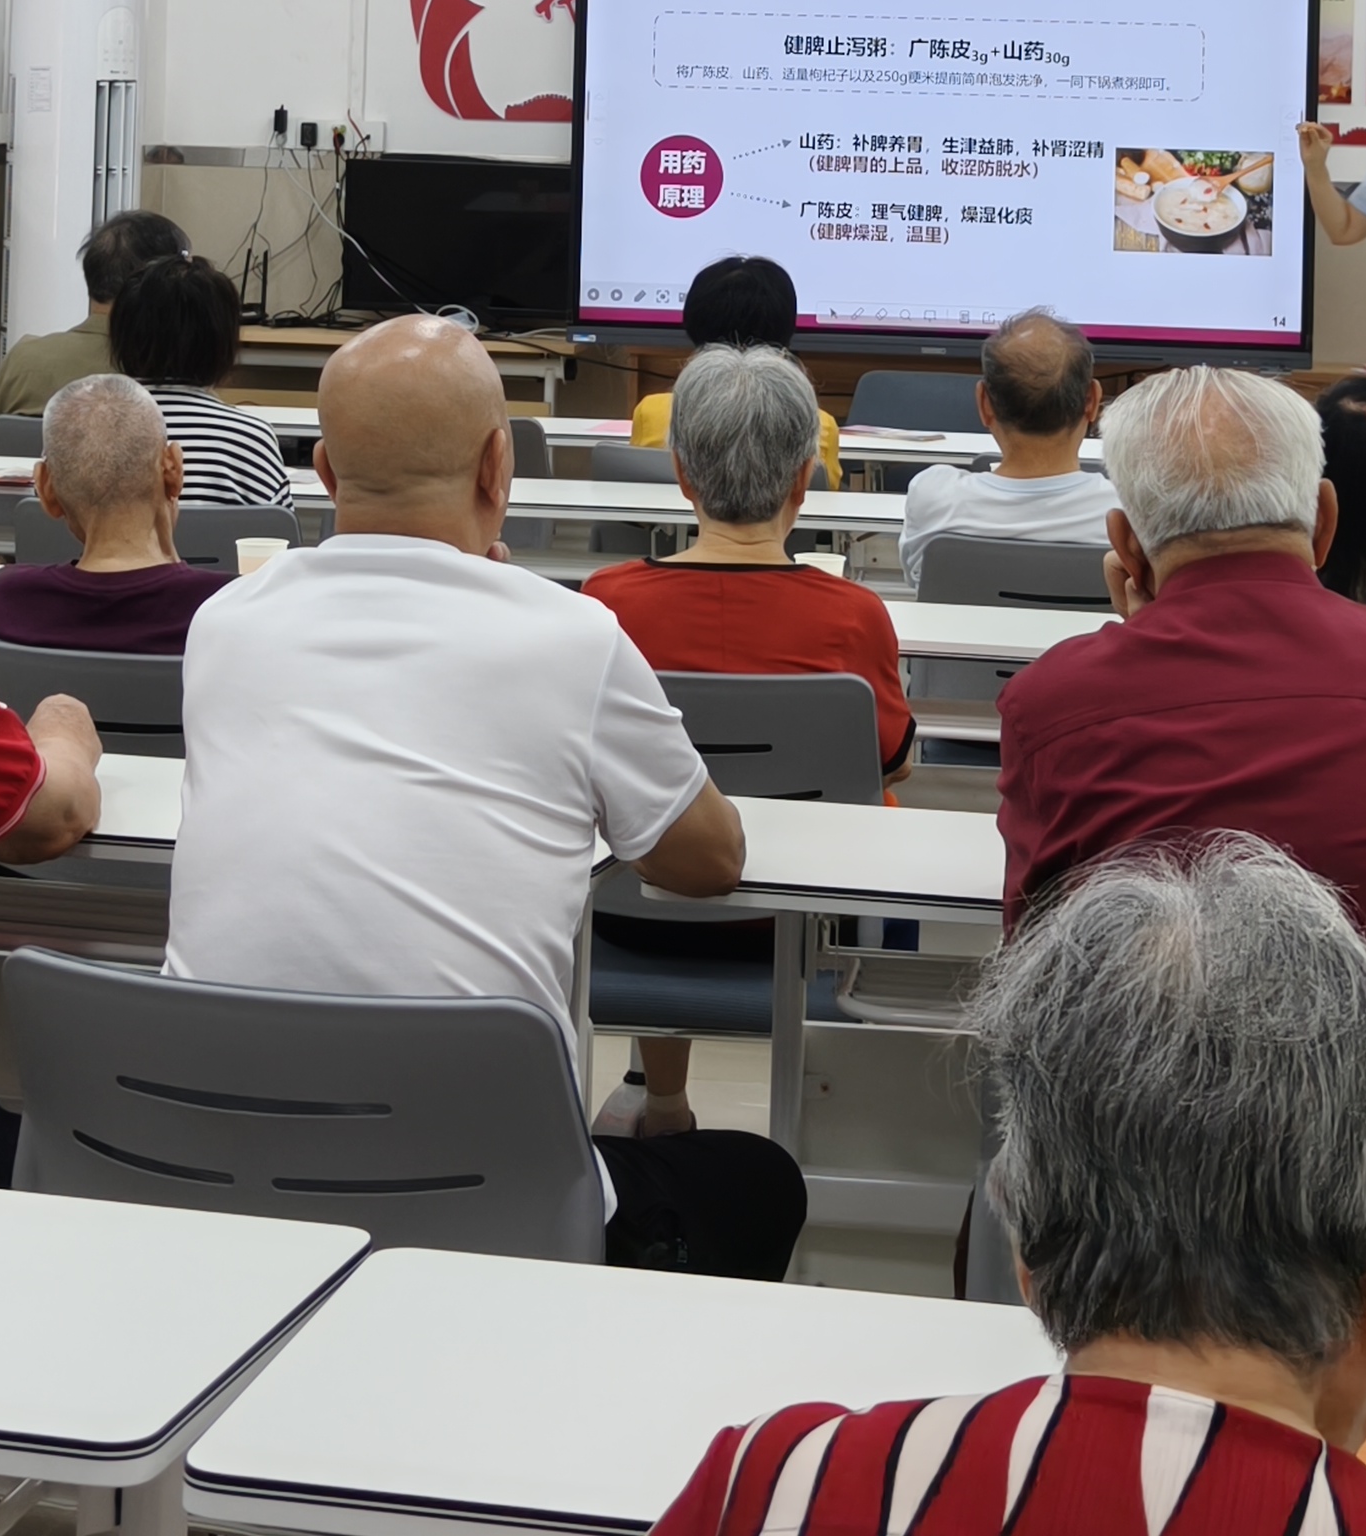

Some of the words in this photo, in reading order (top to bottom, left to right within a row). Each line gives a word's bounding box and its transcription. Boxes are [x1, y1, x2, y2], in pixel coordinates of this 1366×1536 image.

[658, 149, 707, 176] 用药
[657, 184, 706, 210] 原理
[1272, 316, 1287, 328] 14
